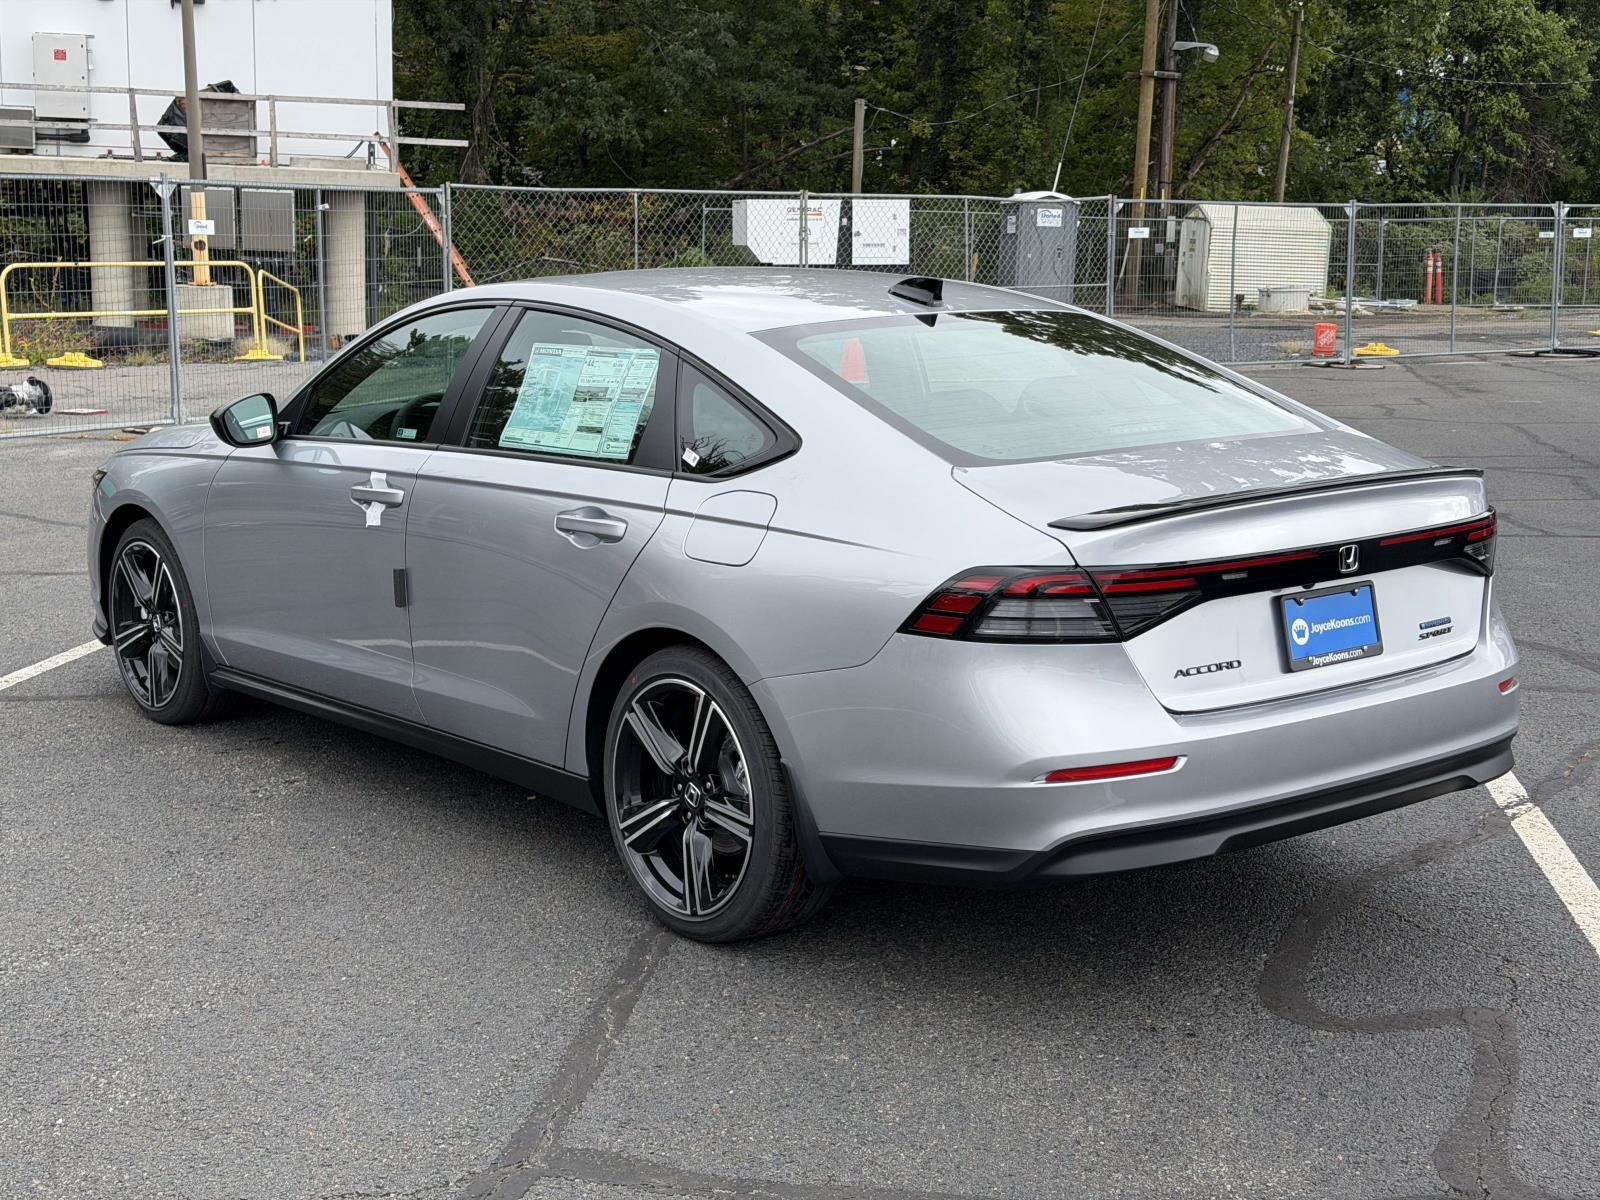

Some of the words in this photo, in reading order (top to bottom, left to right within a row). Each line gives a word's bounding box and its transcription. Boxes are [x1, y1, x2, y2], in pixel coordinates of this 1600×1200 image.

[1310, 614, 1371, 634] JoyceKoons.com
[1418, 625, 1454, 641] SPORT
[1312, 647, 1363, 666] JoyceKoons.com
[1173, 659, 1242, 679] ACCORD
